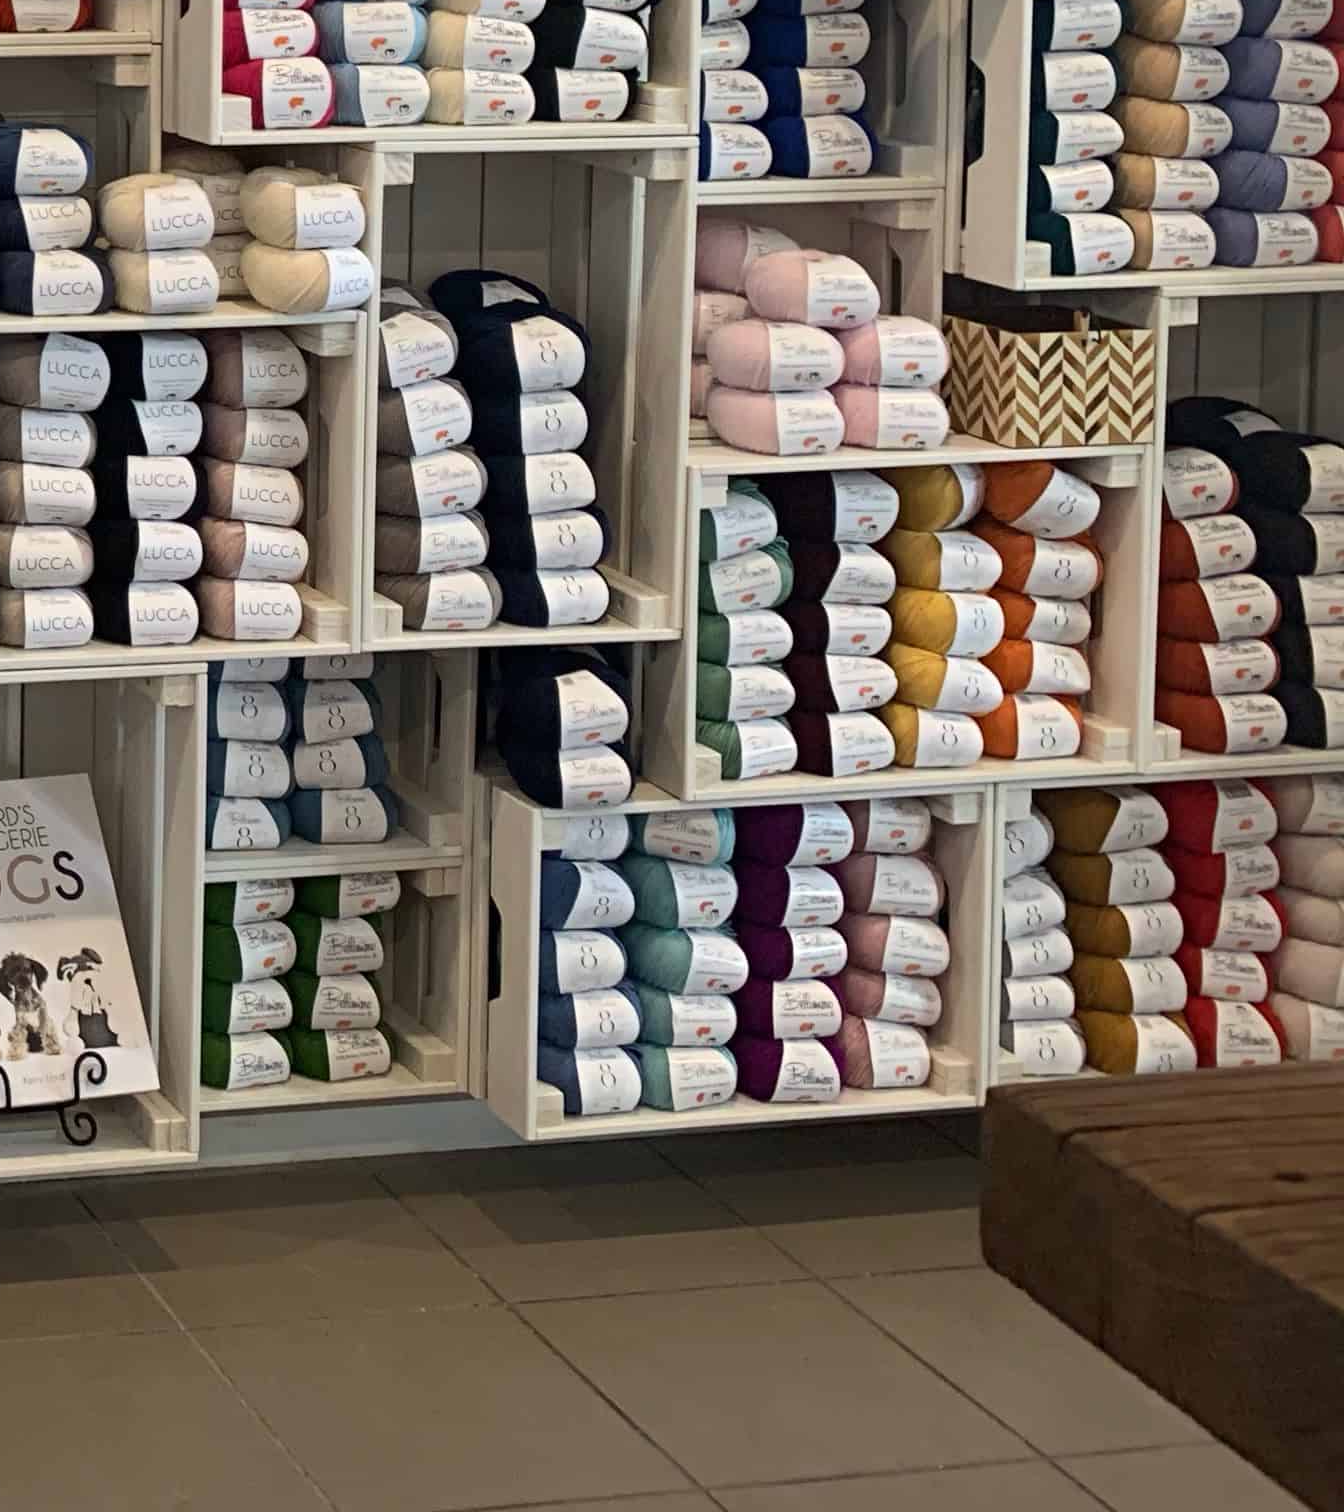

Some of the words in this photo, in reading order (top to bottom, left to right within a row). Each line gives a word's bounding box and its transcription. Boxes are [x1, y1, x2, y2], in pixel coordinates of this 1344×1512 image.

[151, 215, 207, 232] LUCCA
[39, 282, 95, 297] LUCCA
[47, 360, 102, 381] LUCCA
[240, 603, 294, 616] LUCCA
